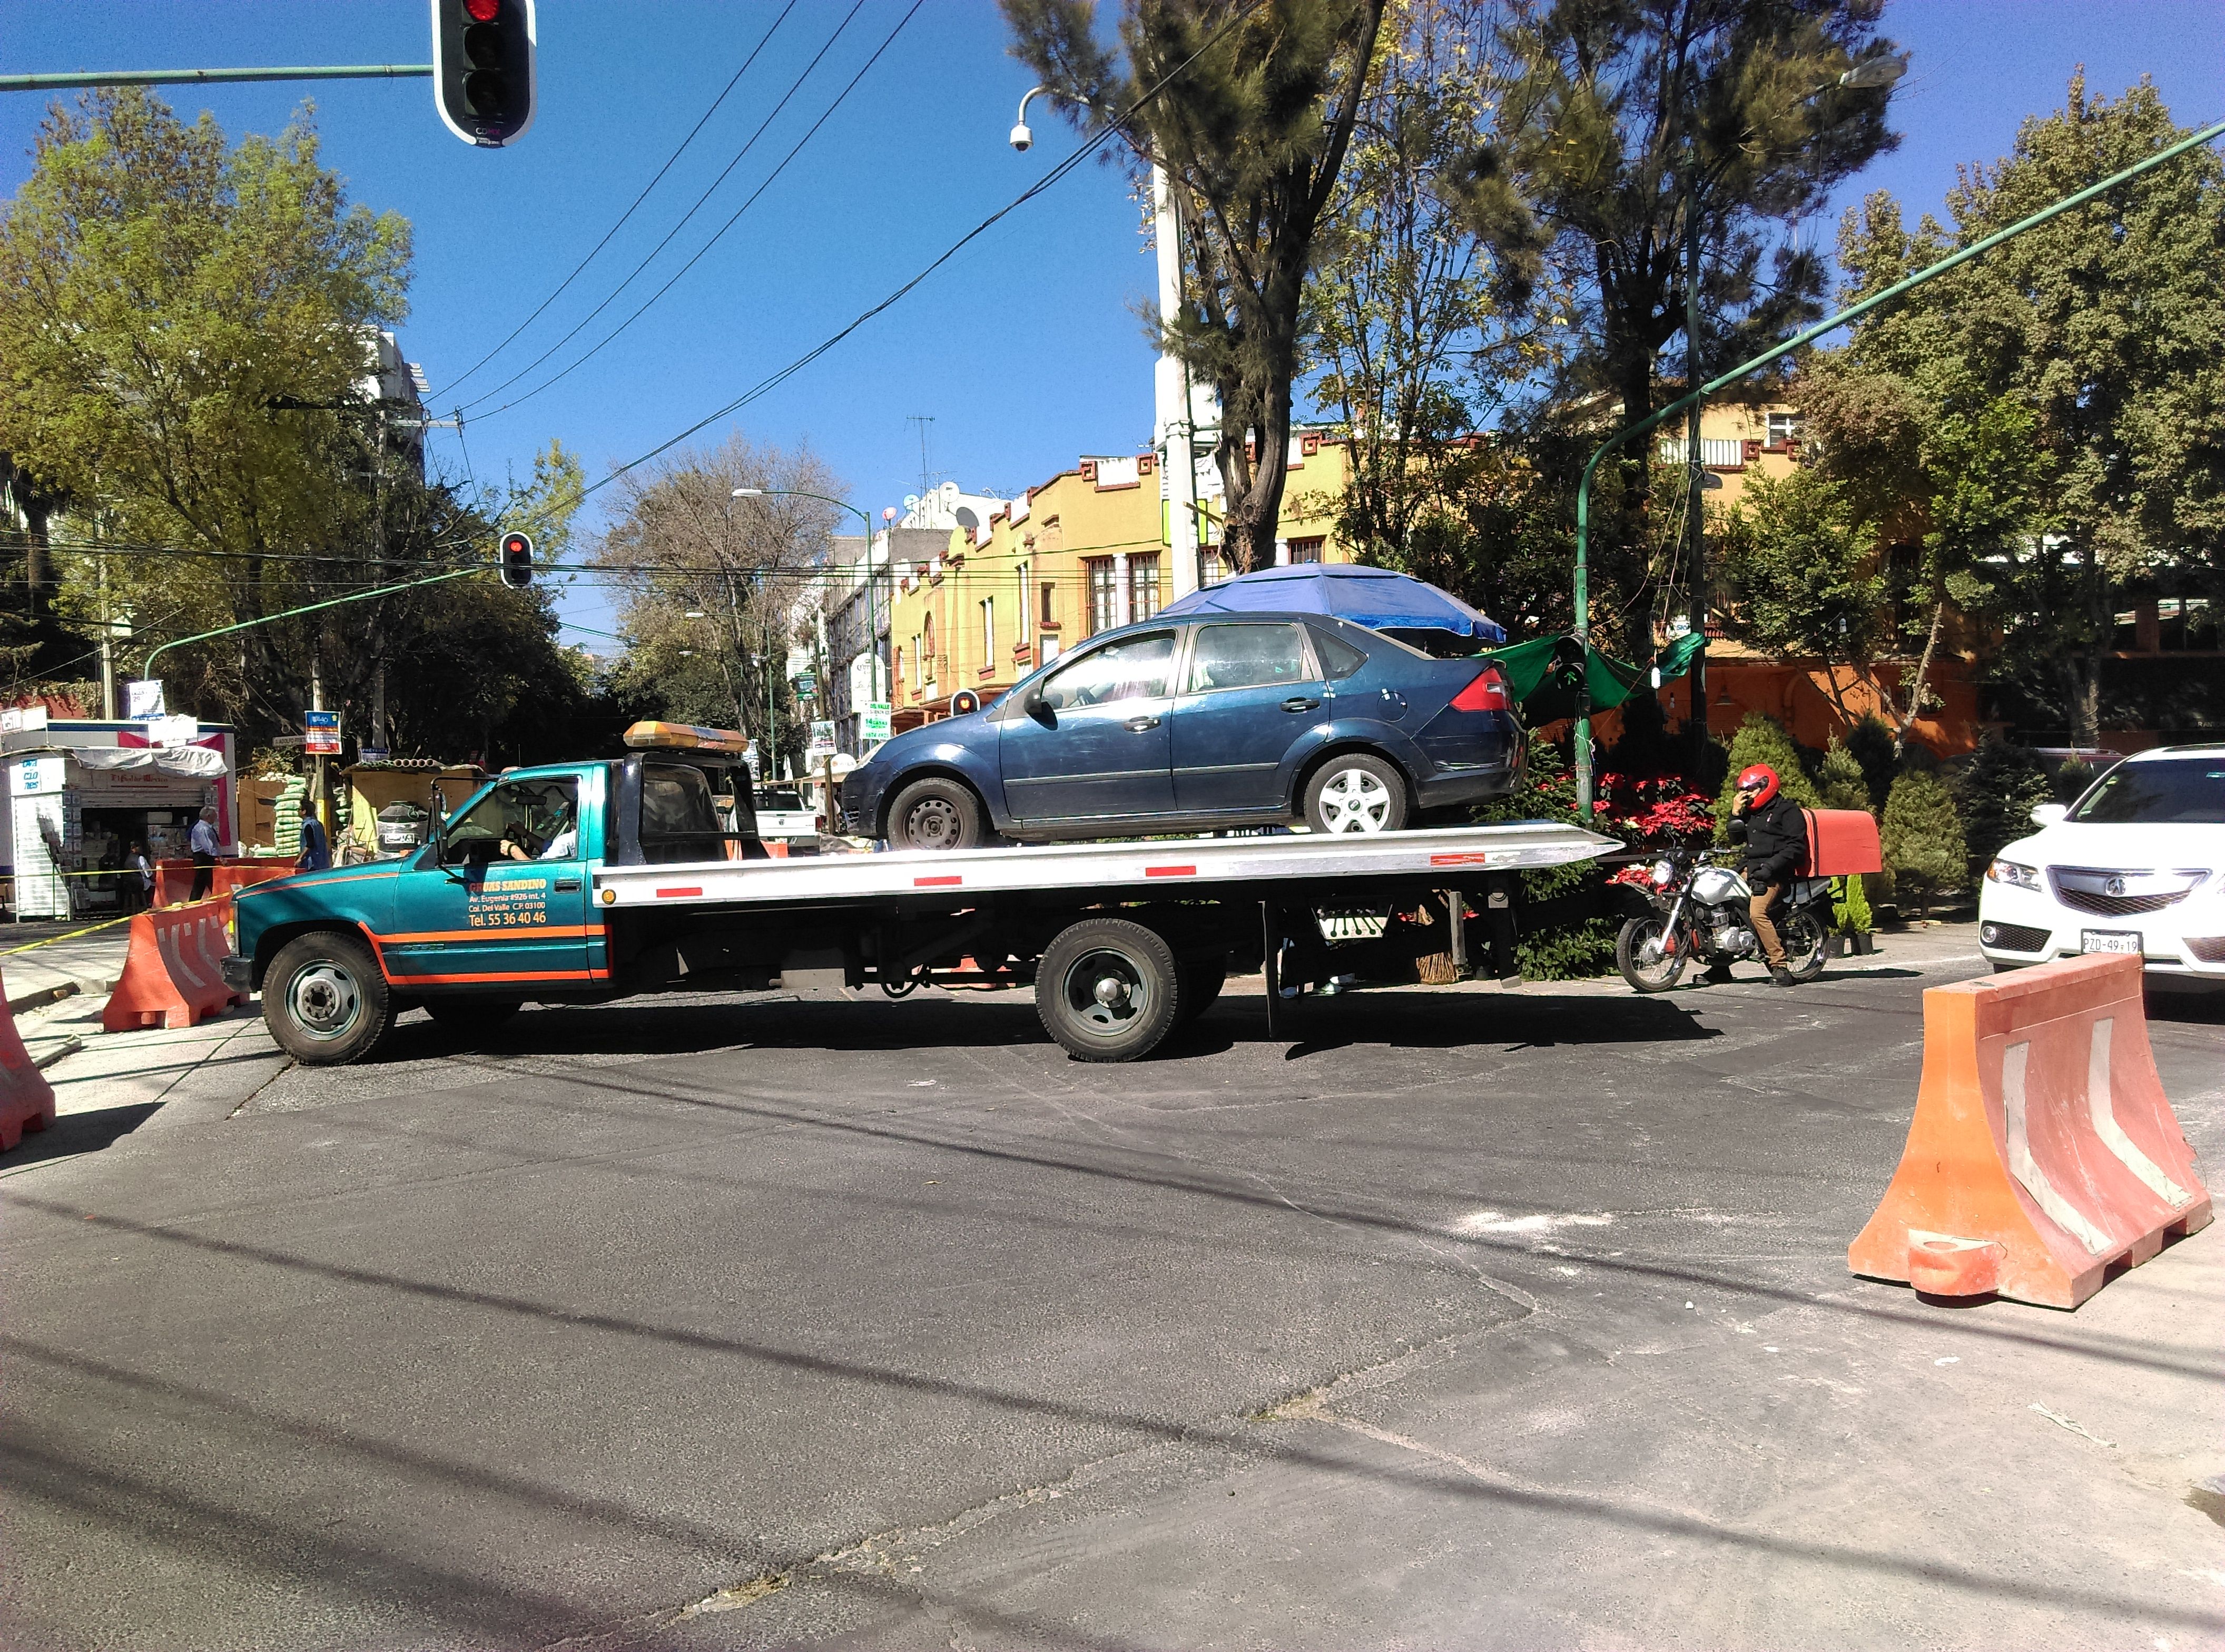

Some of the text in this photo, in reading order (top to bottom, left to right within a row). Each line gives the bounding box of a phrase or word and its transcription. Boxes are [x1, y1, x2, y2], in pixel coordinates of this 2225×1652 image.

[501, 878, 547, 891] SANDINO
[481, 894, 509, 903] Eugenia
[468, 911, 546, 927] Tel. 55 36 40 46
[2083, 938, 2137, 952] PZD-49-19
